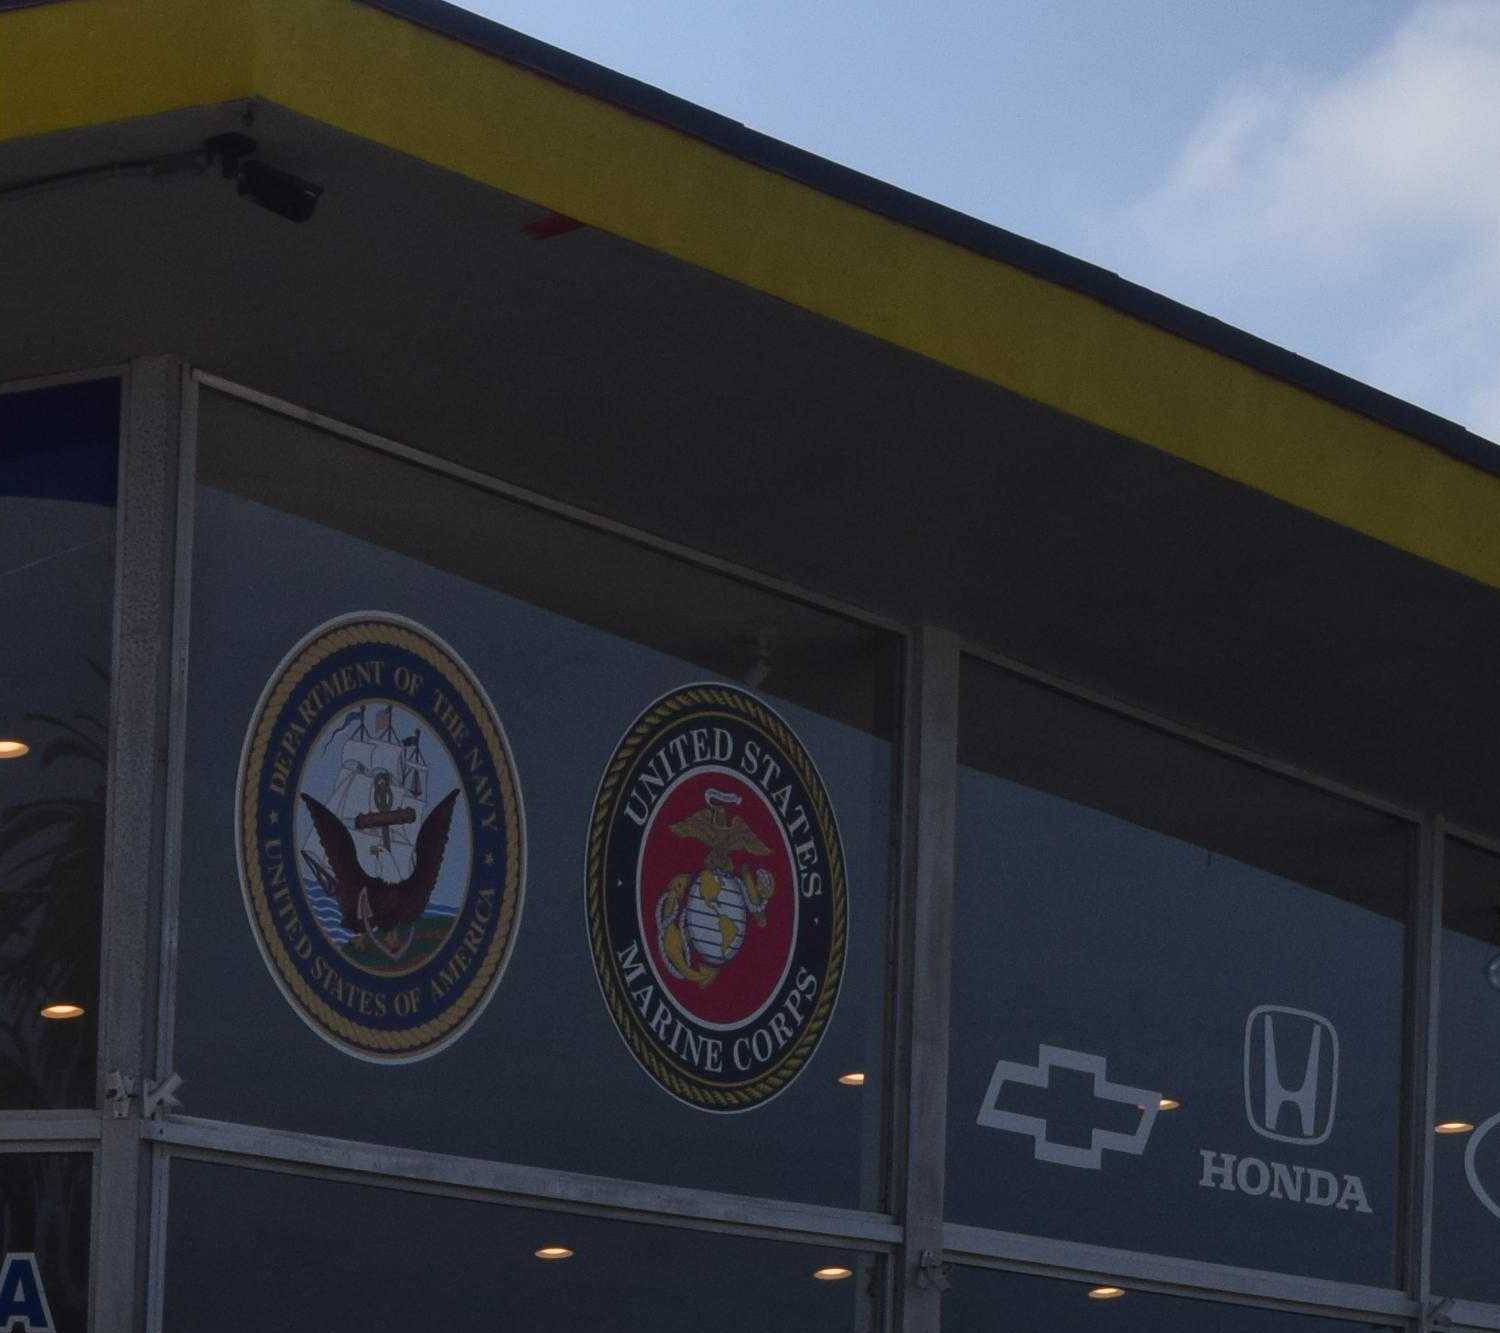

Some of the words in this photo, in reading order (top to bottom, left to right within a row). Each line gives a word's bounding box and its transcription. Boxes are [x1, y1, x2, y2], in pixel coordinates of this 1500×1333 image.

[270, 660, 385, 796] DEPARTMENT
[393, 665, 424, 697] OF
[431, 687, 468, 747] THE
[470, 745, 499, 832] NAVY
[624, 727, 734, 828] UNITED
[741, 739, 824, 899] STATES
[264, 838, 313, 960] UNITED
[310, 957, 386, 1018] STATES
[393, 988, 422, 1016] OF
[428, 888, 497, 1000] AMERICA
[617, 939, 723, 1073] MARINE
[733, 965, 818, 1072] CORPS
[1199, 1149, 1374, 1214] HONDA
